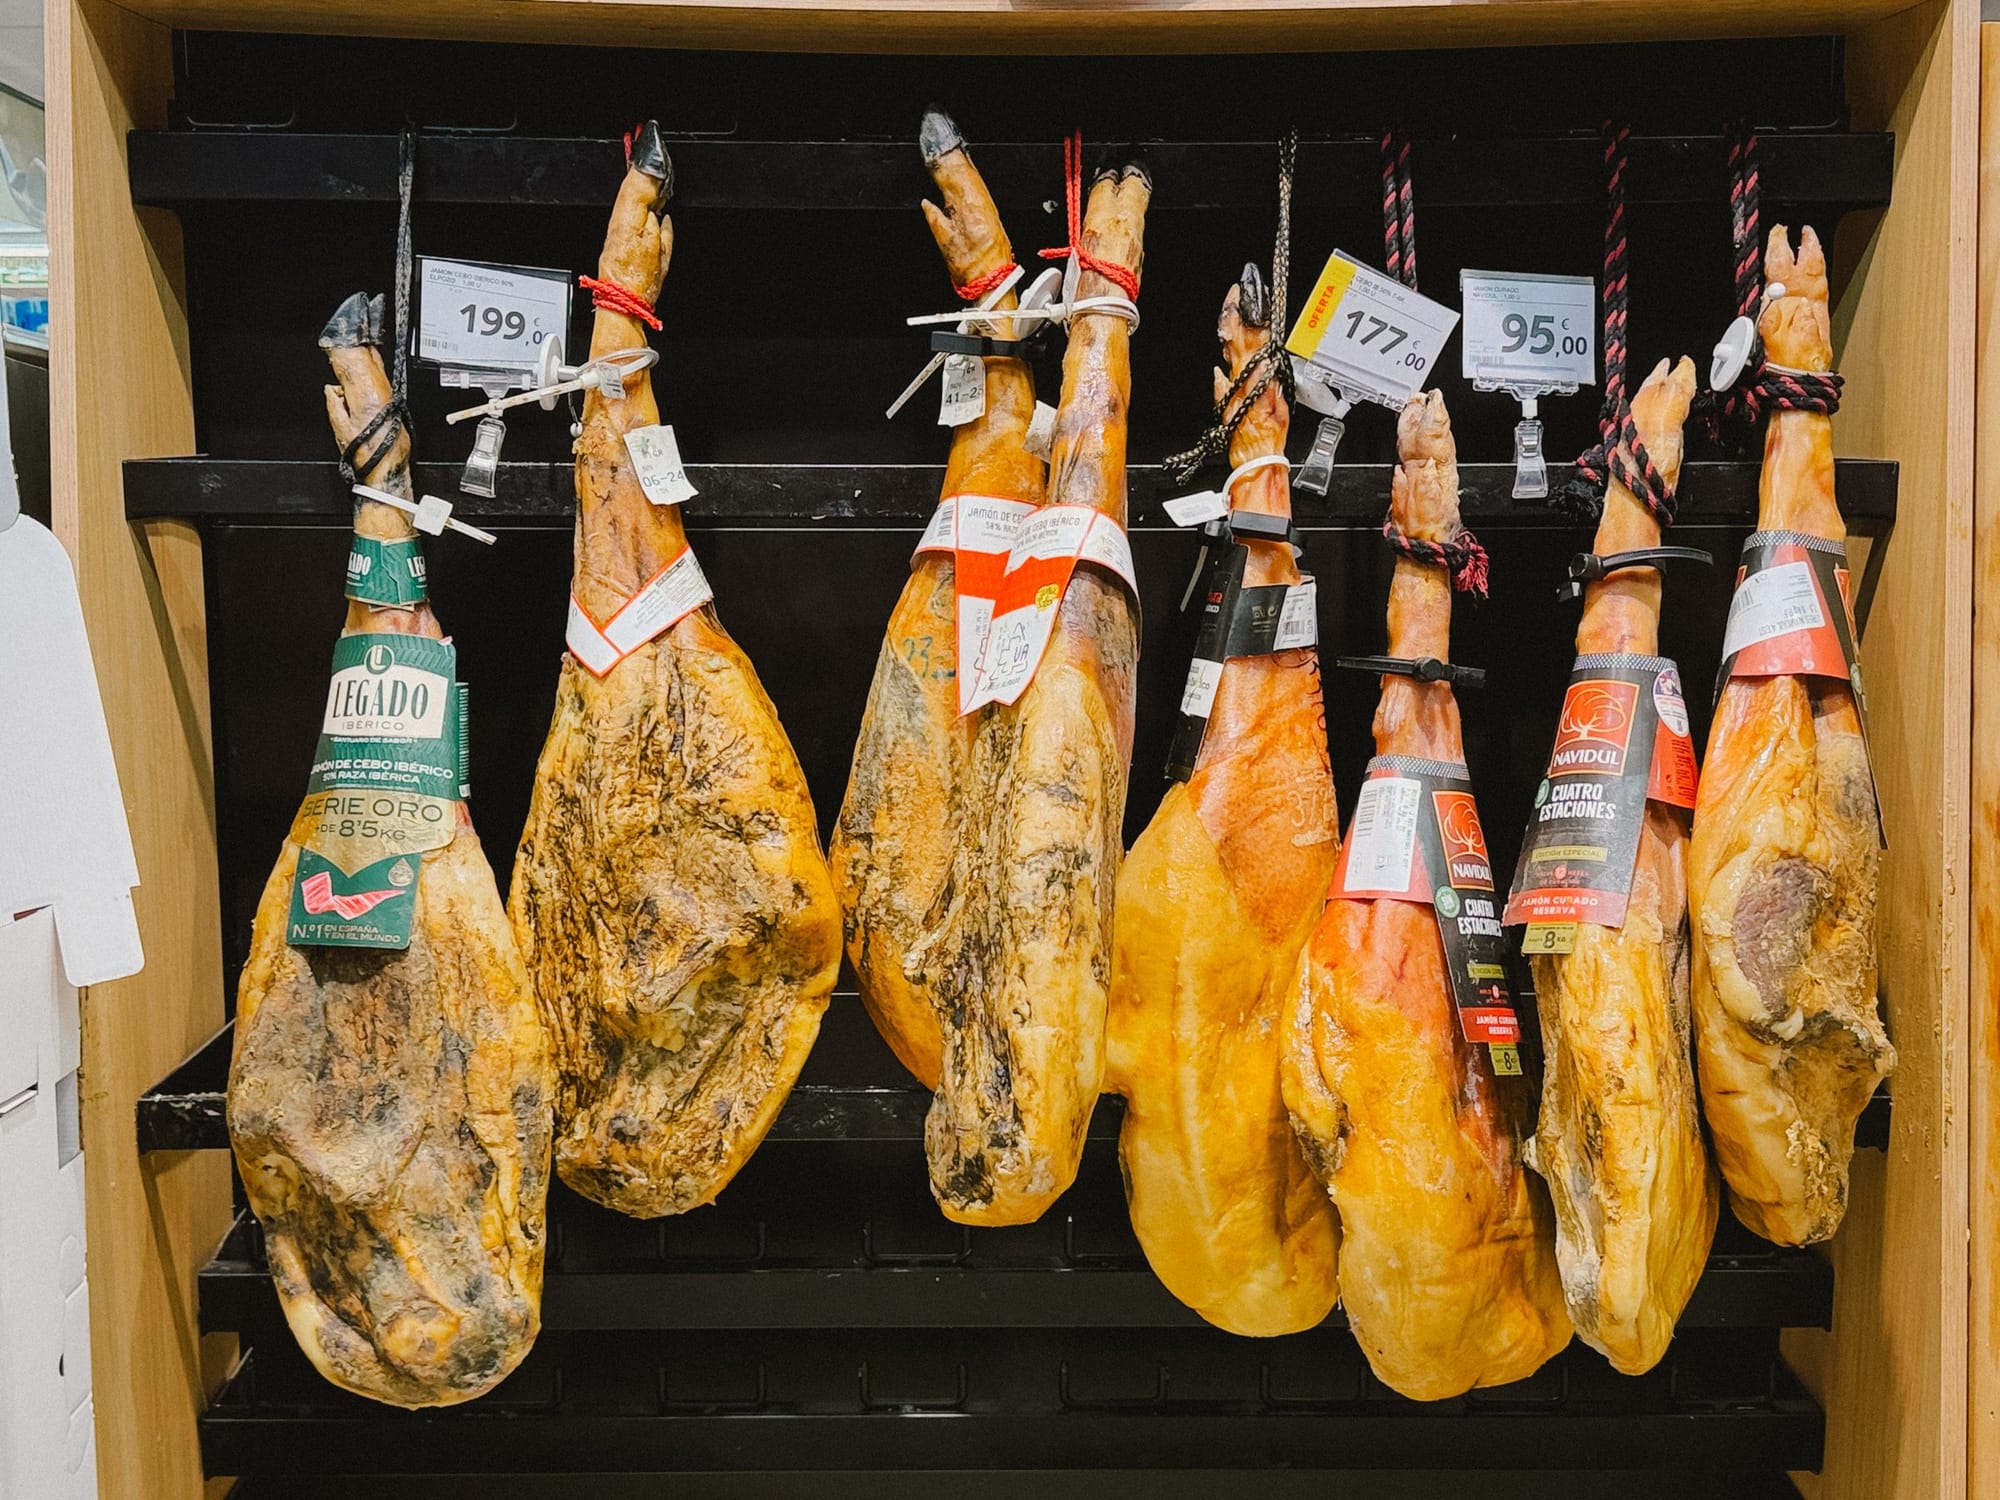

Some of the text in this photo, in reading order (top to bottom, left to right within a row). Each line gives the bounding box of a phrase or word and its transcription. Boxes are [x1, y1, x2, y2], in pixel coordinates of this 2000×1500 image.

[1308, 285, 1336, 329] OFERTA
[1562, 318, 1570, 331] €
[1413, 340, 1421, 350] €
[968, 507, 998, 520] JAMÓN
[1001, 511, 1010, 522] DE
[1050, 513, 1080, 527] IBÉRICO
[332, 679, 429, 720] LEGADO
[343, 720, 405, 731] IBÉRICO
[1553, 748, 1620, 767] NAVIDUL
[336, 760, 352, 769] DE
[353, 759, 392, 770] CEBO
[394, 761, 454, 779] IBÉRICO
[338, 770, 366, 779] RAZA
[368, 771, 420, 784] IBÉRICA
[1551, 783, 1604, 801] CUATRO
[303, 797, 443, 822] SERIE ORO
[1539, 801, 1617, 822] ESTACIONES
[1521, 894, 1599, 907] JAMÓN CURADO
[1533, 906, 1576, 915] RESERVA
[339, 924, 379, 933] ESPAÑA
[360, 934, 401, 943] MUNDO
[1543, 931, 1556, 949] 8
[1504, 1051, 1512, 1071] 8
